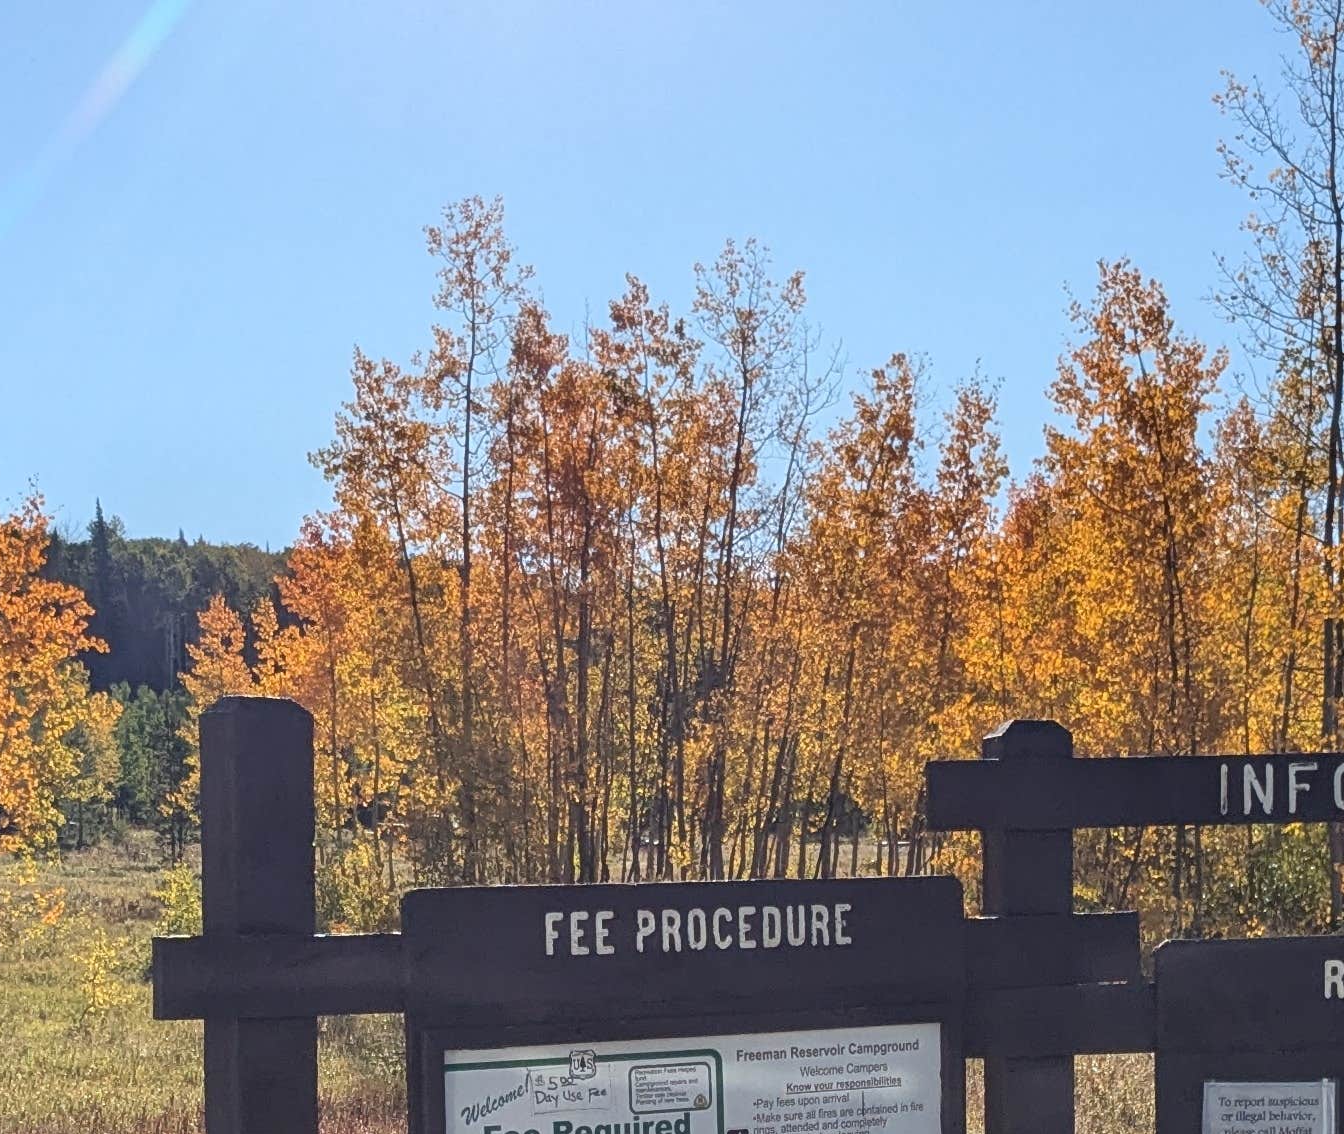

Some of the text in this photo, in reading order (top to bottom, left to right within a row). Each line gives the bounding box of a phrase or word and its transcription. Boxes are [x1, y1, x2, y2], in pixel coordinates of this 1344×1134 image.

[545, 904, 852, 955] FEE PROCEDURE
[736, 1039, 919, 1062] Freeman Reservoir Campground
[800, 1062, 888, 1077] Welcome Campers
[786, 1077, 902, 1092] Know your responsibilities
[535, 1088, 606, 1107] Day Use Fee
[756, 1093, 849, 1109] Pay fees upon arrival
[1218, 1097, 1319, 1109] To report suspicious
[757, 1102, 923, 1123] Make sure all fires are contained in fire
[1236, 1111, 1265, 1124] illegal
[1269, 1111, 1316, 1122] behavior,
[781, 1122, 819, 1133] attended
[822, 1120, 838, 1130] and
[841, 1117, 887, 1129] completely
